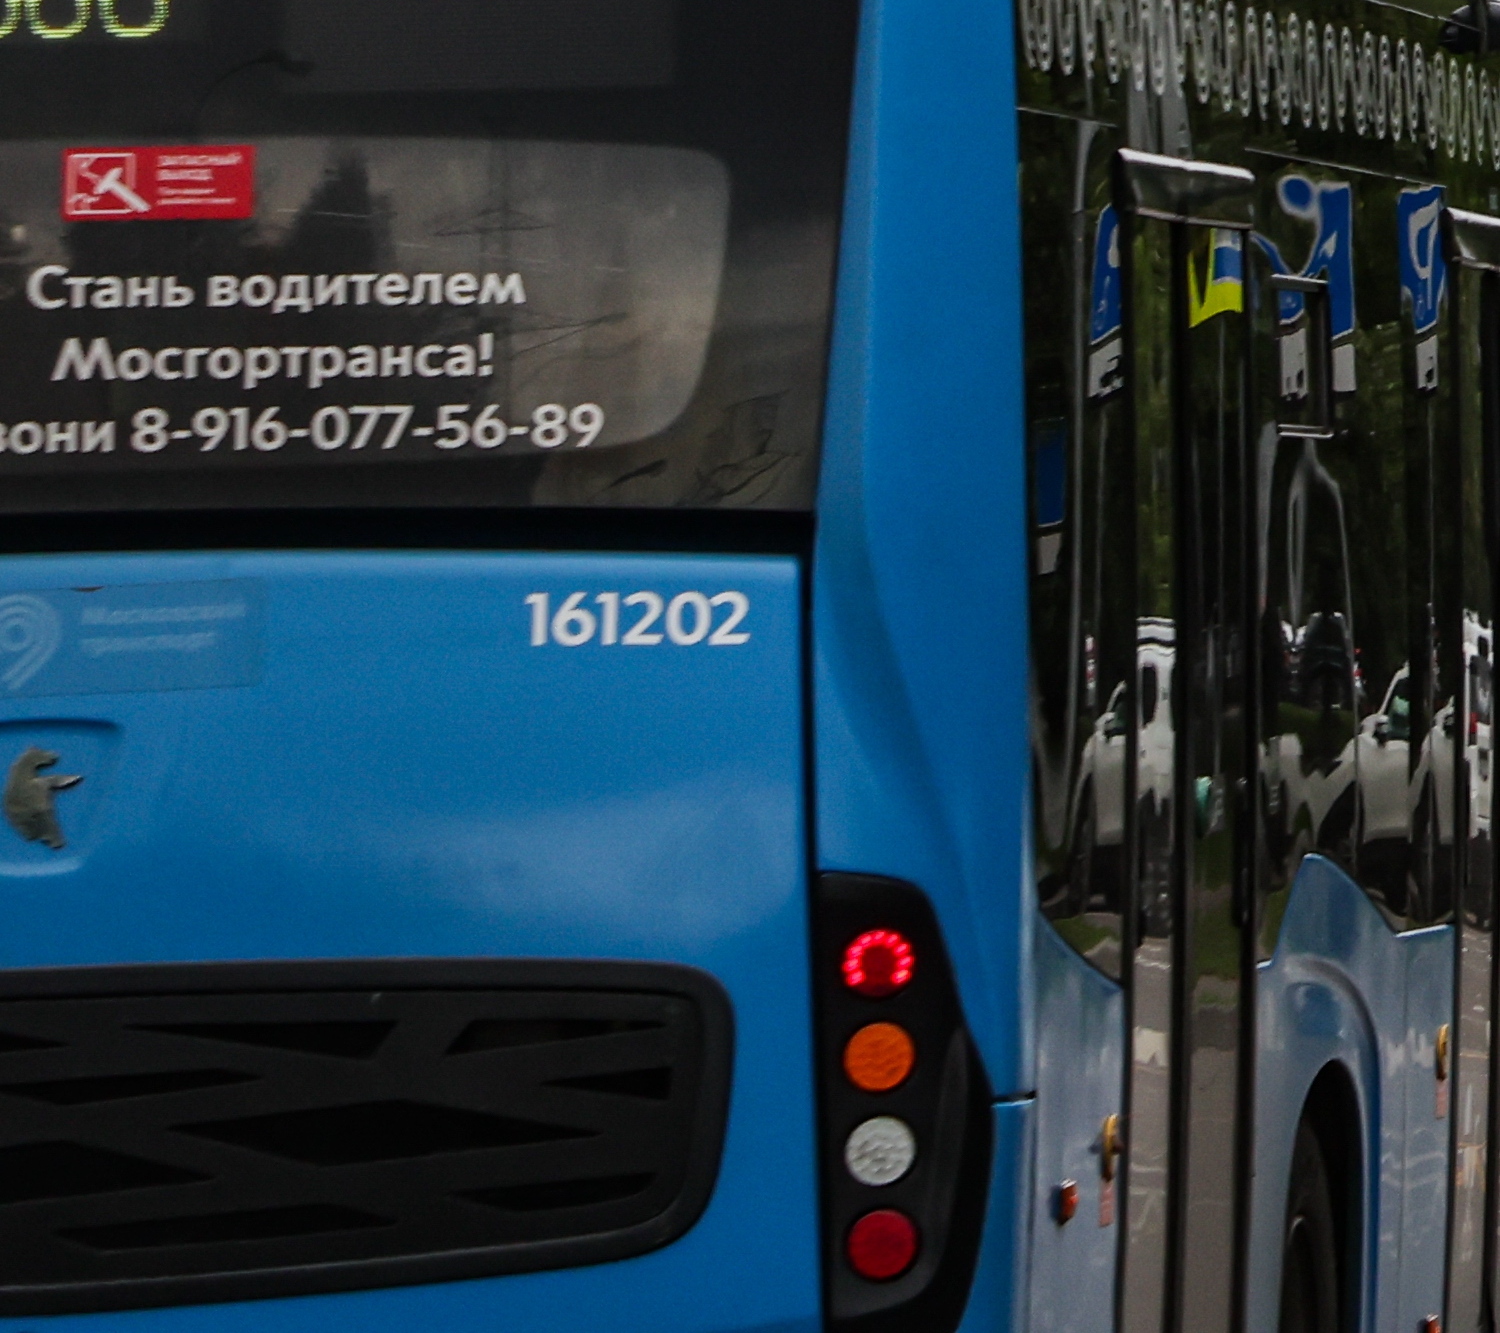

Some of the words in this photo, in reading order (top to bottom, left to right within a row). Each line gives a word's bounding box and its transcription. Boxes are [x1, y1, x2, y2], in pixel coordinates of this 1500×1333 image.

[27, 266, 195, 309] Стань
[206, 272, 527, 314] водителем
[51, 333, 495, 389] Мосгортранса!
[131, 403, 605, 452] 8-916-077-56-89
[524, 590, 752, 647] 161202
